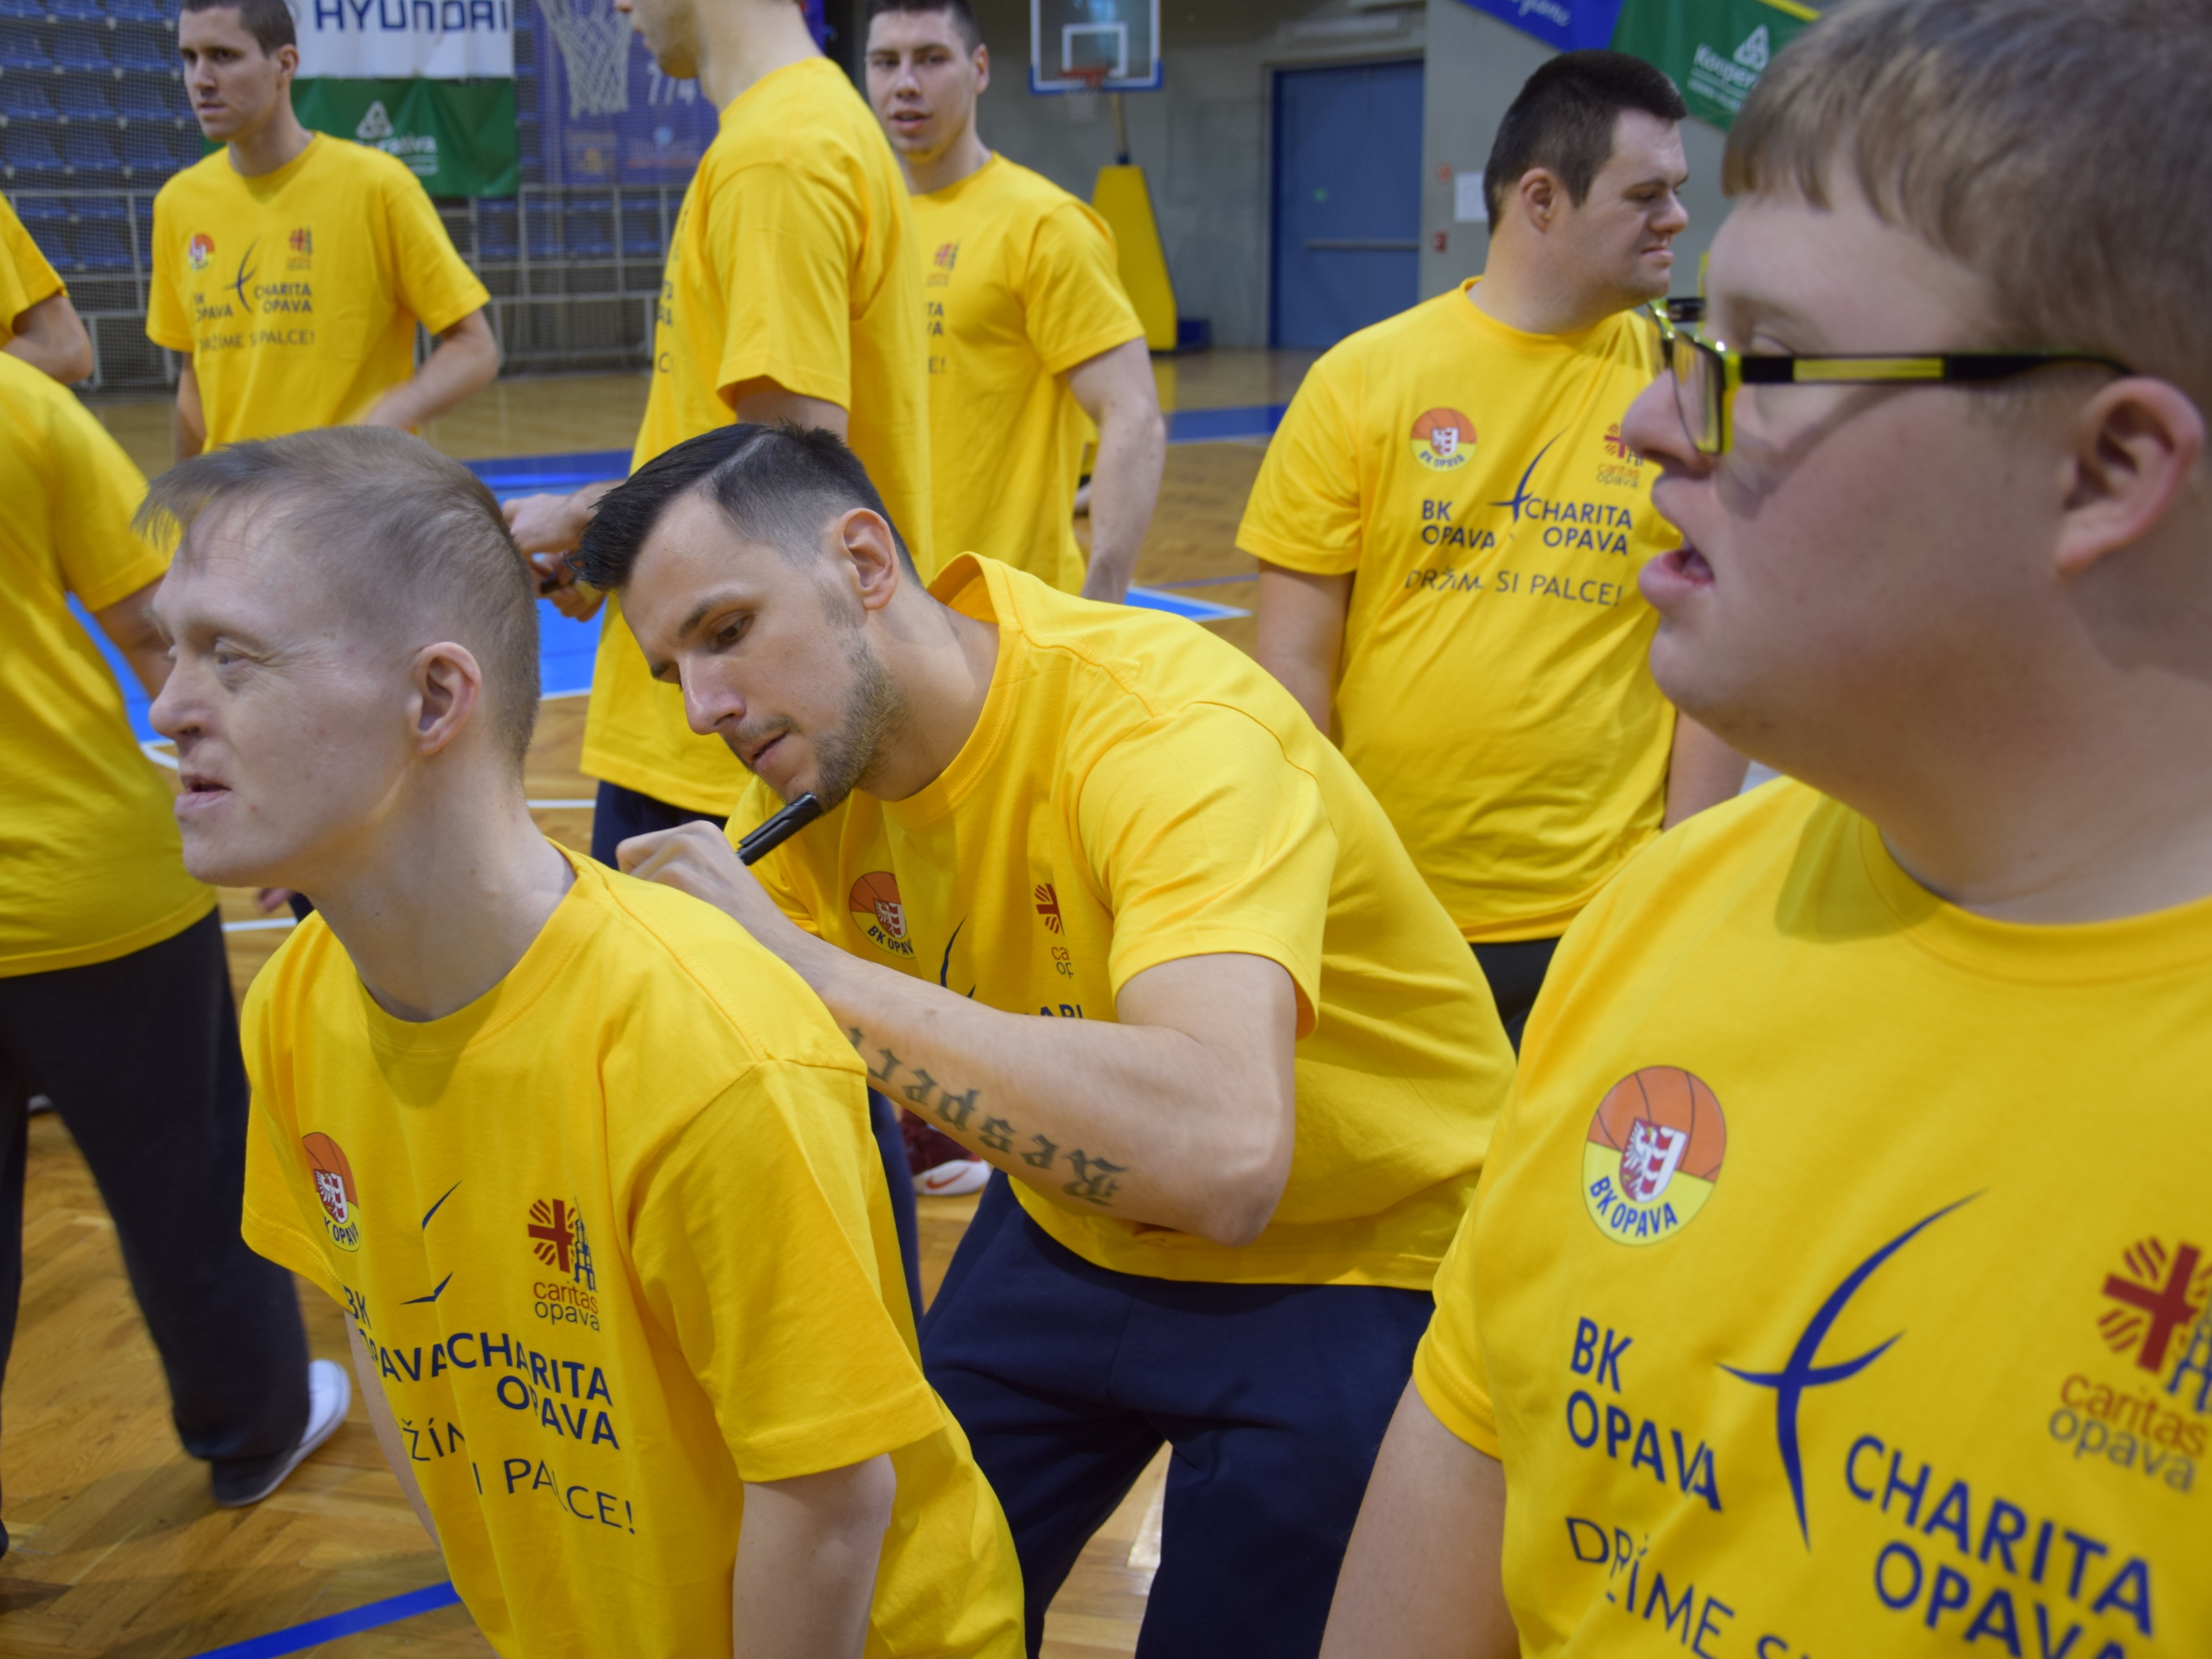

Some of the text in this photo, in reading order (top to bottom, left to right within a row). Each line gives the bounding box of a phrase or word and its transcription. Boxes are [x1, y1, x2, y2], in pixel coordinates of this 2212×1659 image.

[314, 0, 507, 31] HYUNDAI
[263, 300, 312, 314] OPAVA
[1422, 499, 1452, 521] BK
[1525, 497, 1633, 530] CHARITA
[1421, 525, 1496, 551] OPAVA
[1543, 526, 1628, 556] OPAVA
[1496, 570, 1519, 593] SI
[1530, 574, 1623, 607] PALCE!
[868, 925, 914, 955] BK OPAV
[1590, 1176, 1678, 1237] BK OPAVA
[533, 1281, 598, 1315] caritas
[534, 1302, 601, 1333] opava
[446, 1332, 614, 1407] CHARITA
[1570, 1316, 1633, 1394] BK
[497, 1375, 620, 1450] OPAVA
[2060, 1373, 2209, 1460] caritas
[1567, 1389, 1722, 1513] OPAVA
[2048, 1407, 2197, 1494] opava
[1845, 1434, 2154, 1639] CHARITA
